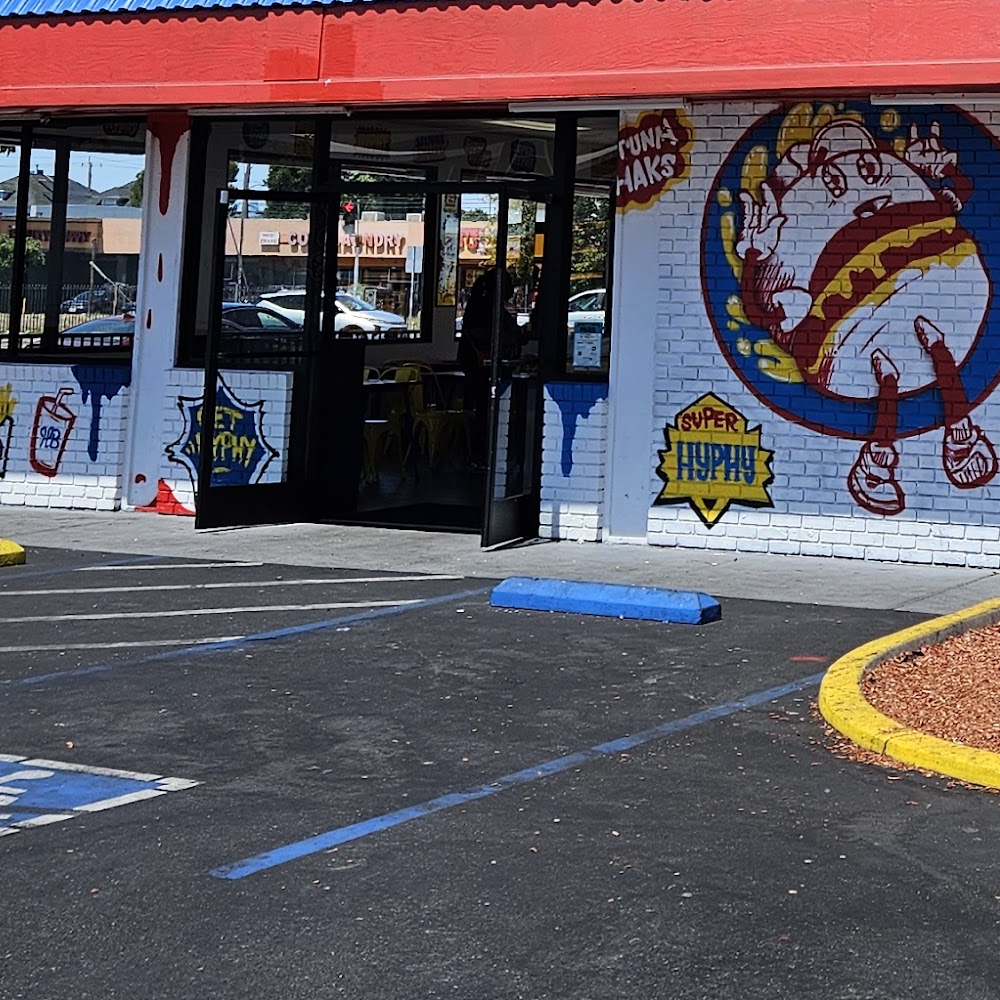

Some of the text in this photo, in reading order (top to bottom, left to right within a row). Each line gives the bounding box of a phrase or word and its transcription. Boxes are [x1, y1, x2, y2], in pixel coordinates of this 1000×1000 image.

[616, 153, 677, 196] HAKS
[338, 232, 405, 247] ANDRY
[681, 406, 739, 432] SUPER
[195, 431, 257, 468] YPHY
[676, 440, 756, 485] HYPHY
